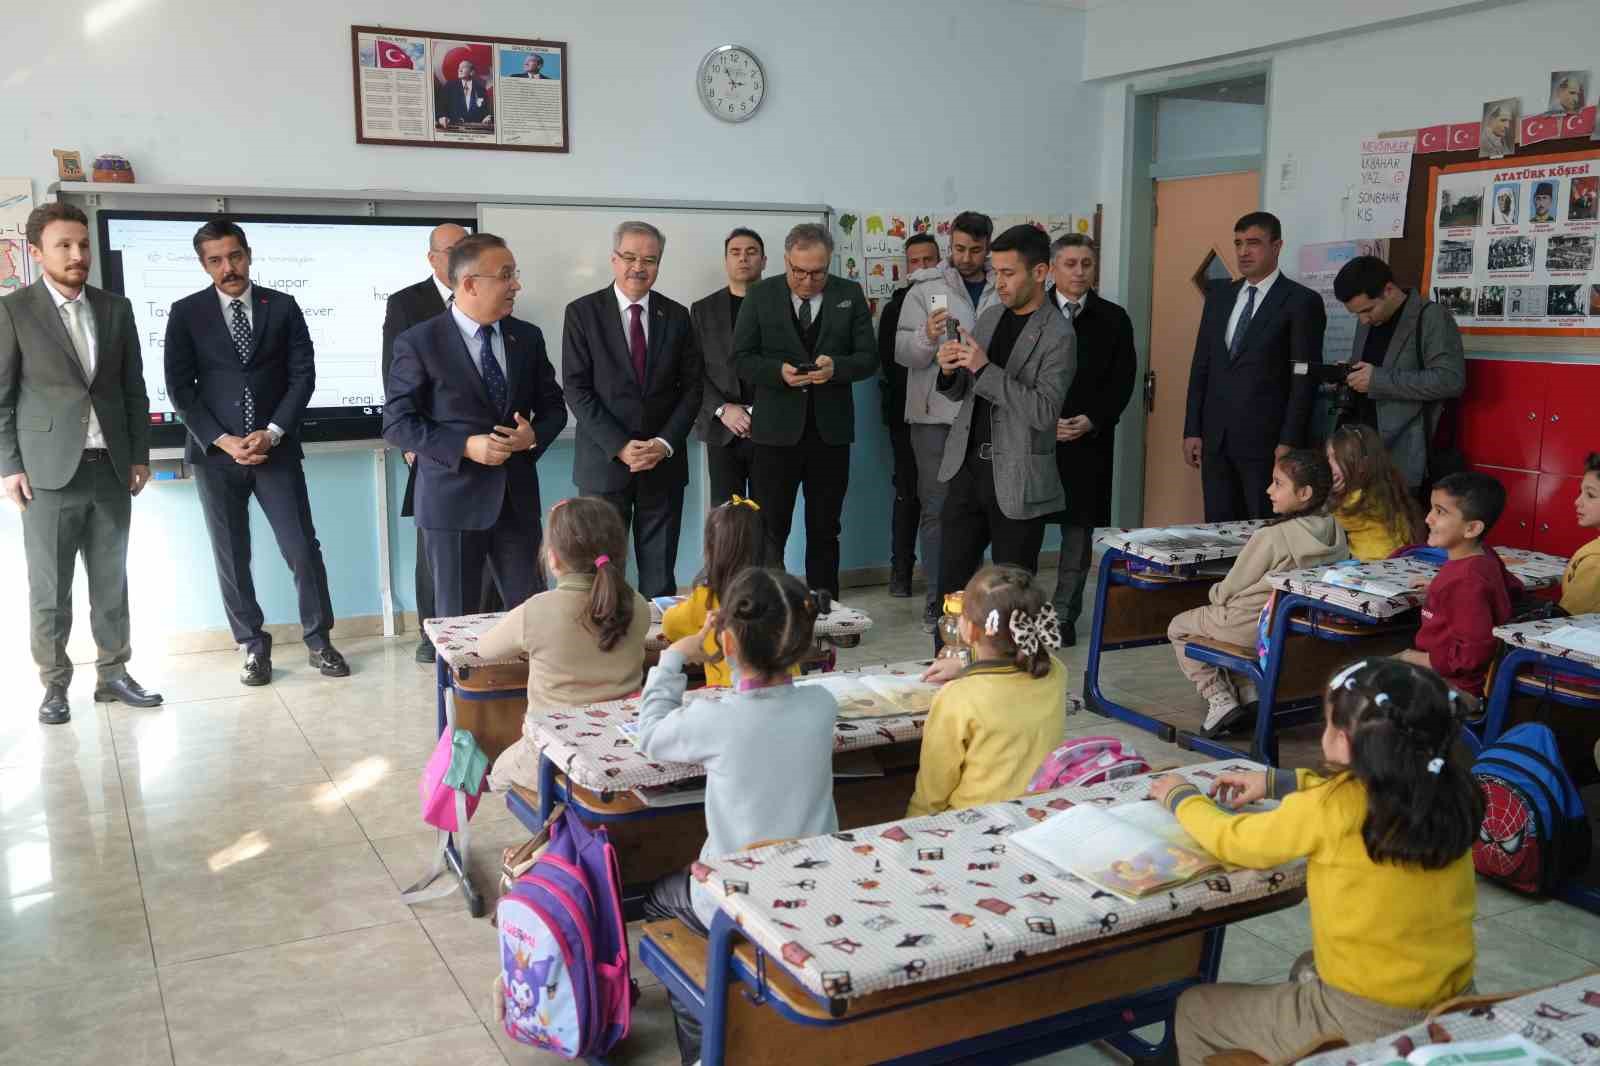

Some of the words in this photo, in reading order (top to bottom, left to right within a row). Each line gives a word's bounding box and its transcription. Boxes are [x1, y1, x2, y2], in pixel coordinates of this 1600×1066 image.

[1361, 171, 1383, 184] YAZ
[1494, 167, 1546, 182] ATATÜRK
[1550, 163, 1590, 178] KÖŞESİ
